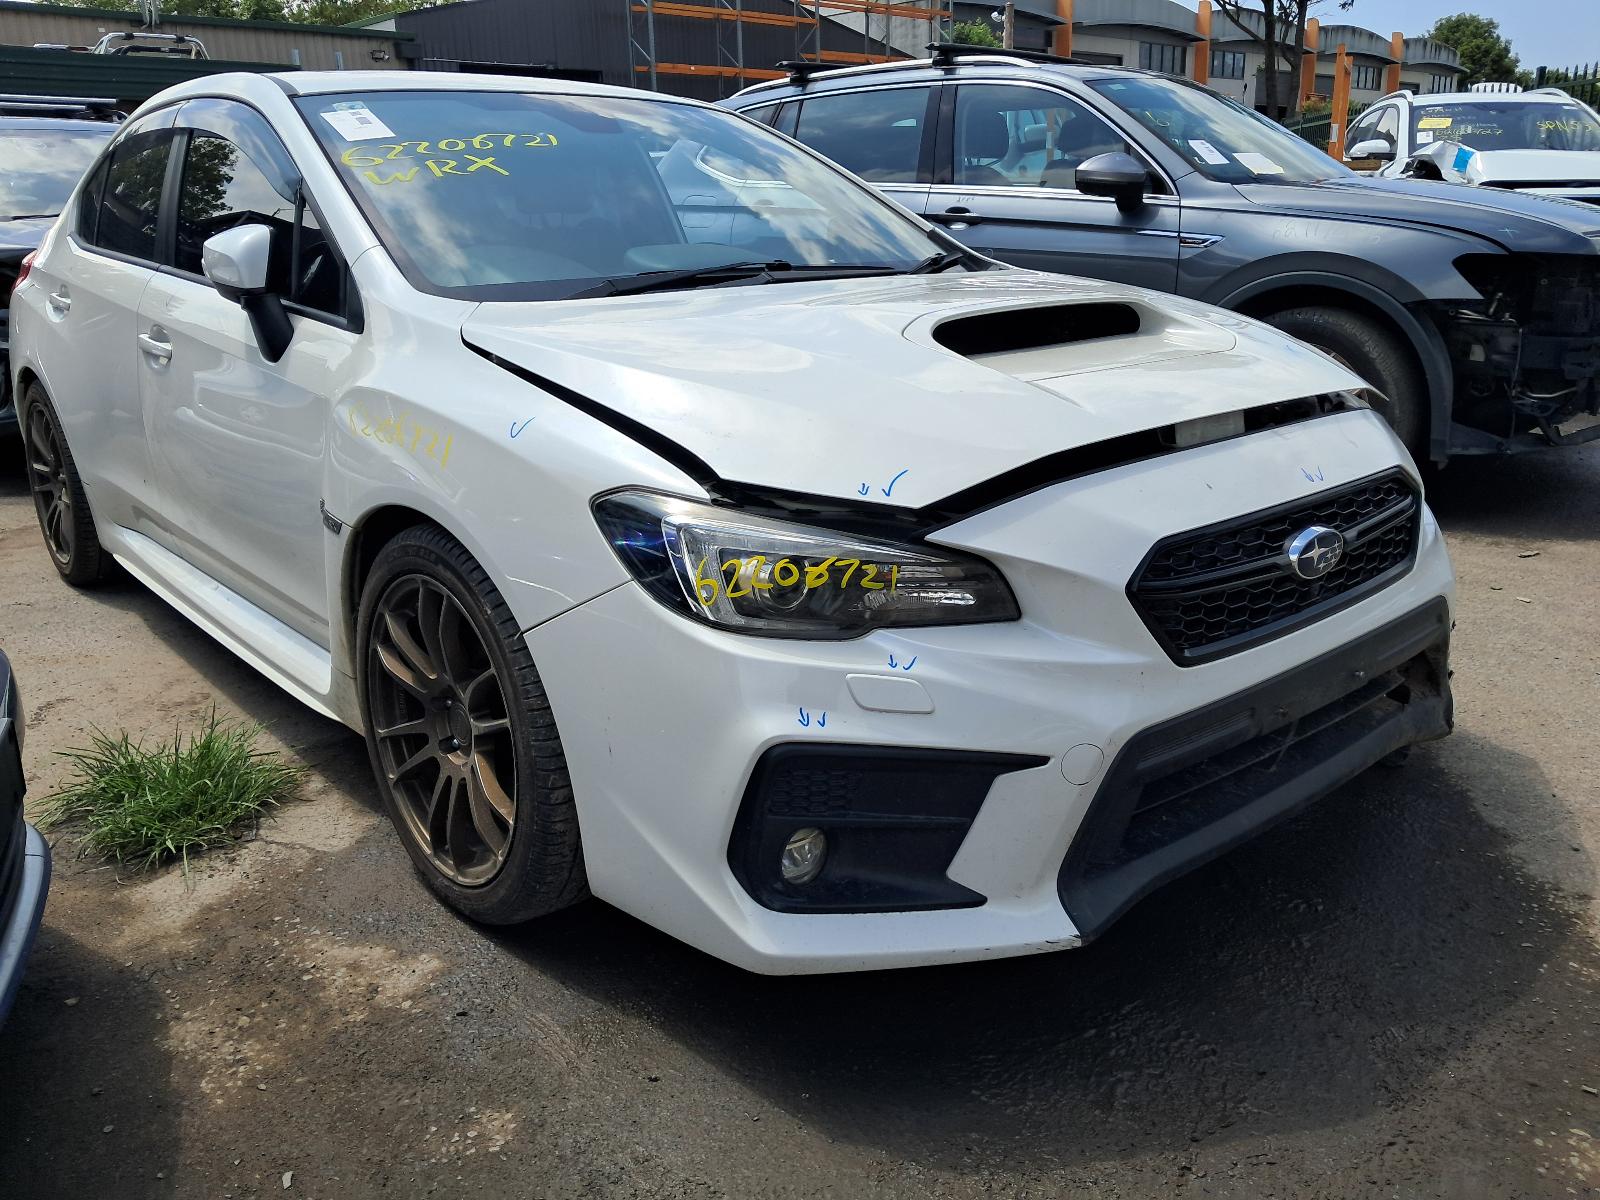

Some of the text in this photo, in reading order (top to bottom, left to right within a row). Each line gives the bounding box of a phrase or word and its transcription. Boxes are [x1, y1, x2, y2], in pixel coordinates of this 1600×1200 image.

[341, 133, 559, 168] 62206721
[363, 154, 511, 186] WRX
[695, 555, 899, 607] 62206721
